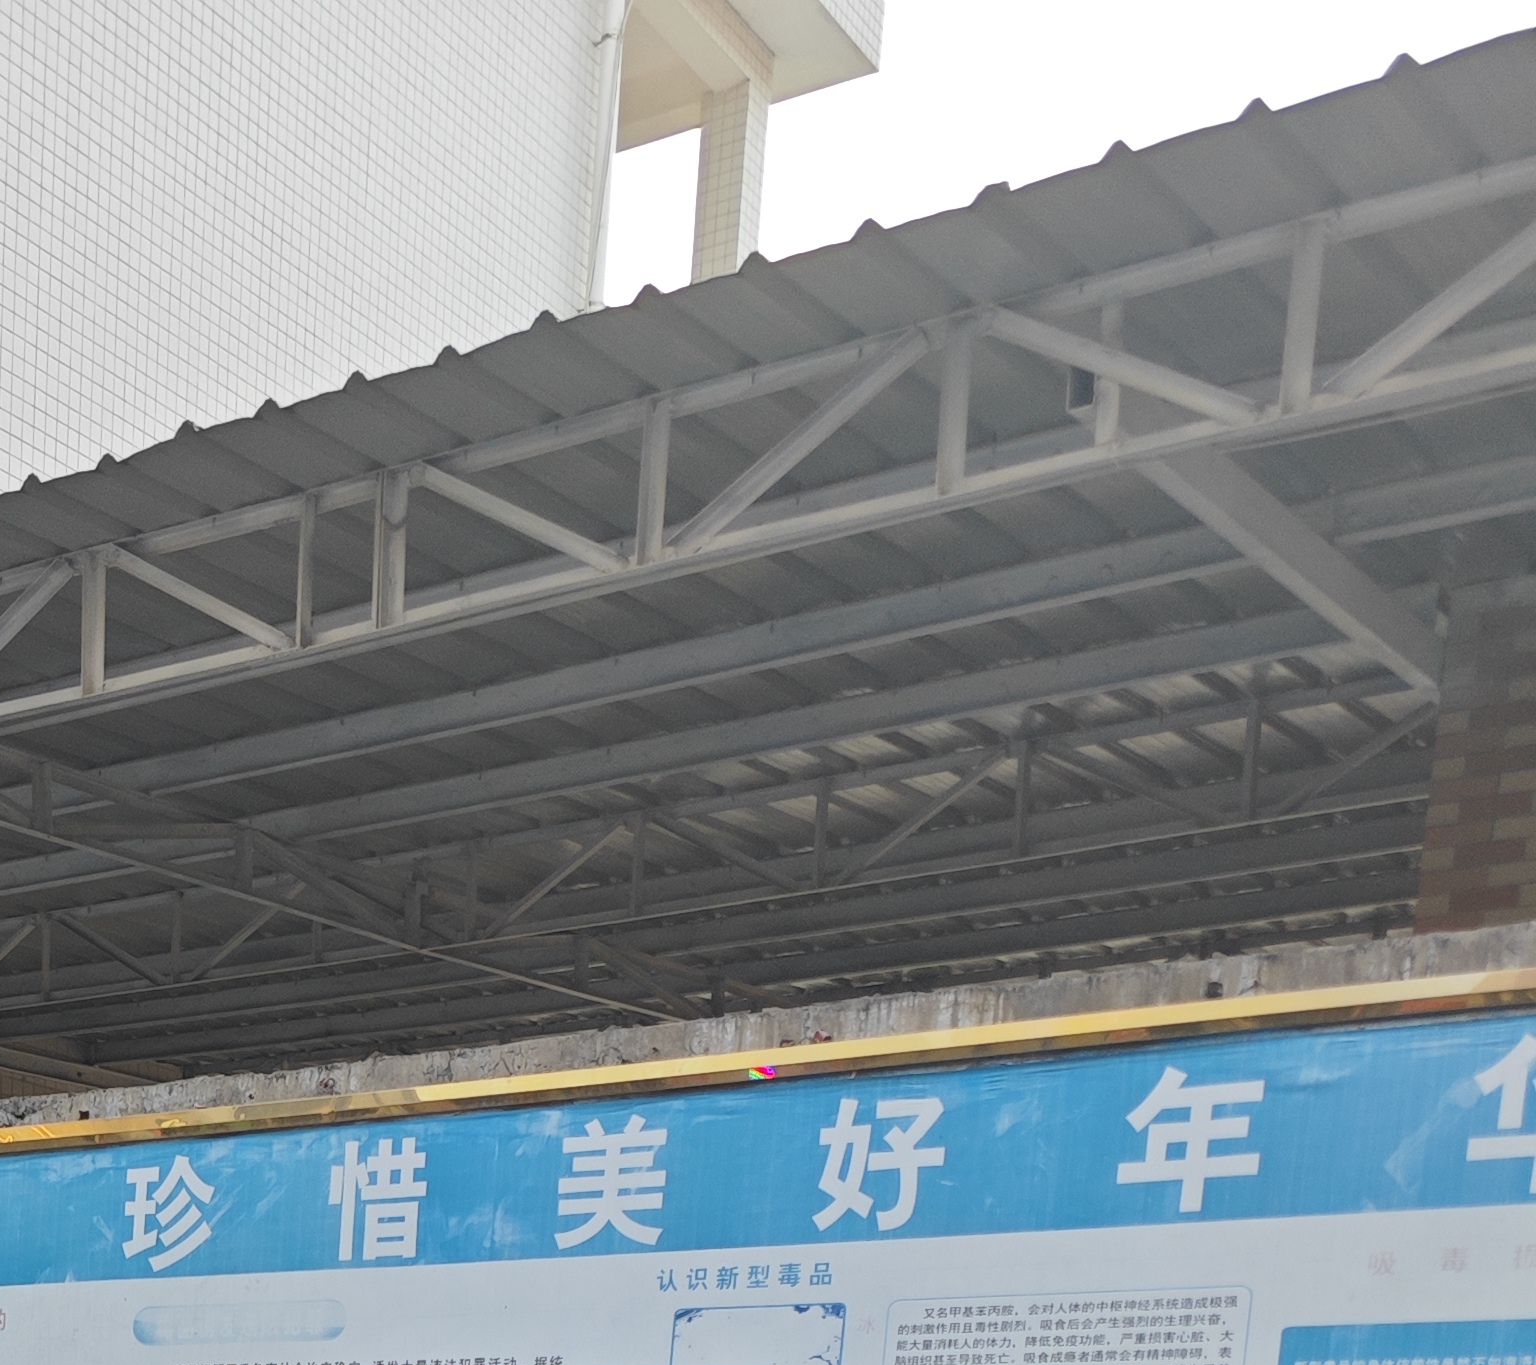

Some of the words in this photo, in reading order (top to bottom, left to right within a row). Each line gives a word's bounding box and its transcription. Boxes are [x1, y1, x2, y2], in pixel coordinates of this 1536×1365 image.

[657, 1261, 833, 1292] 认识新型毒品
